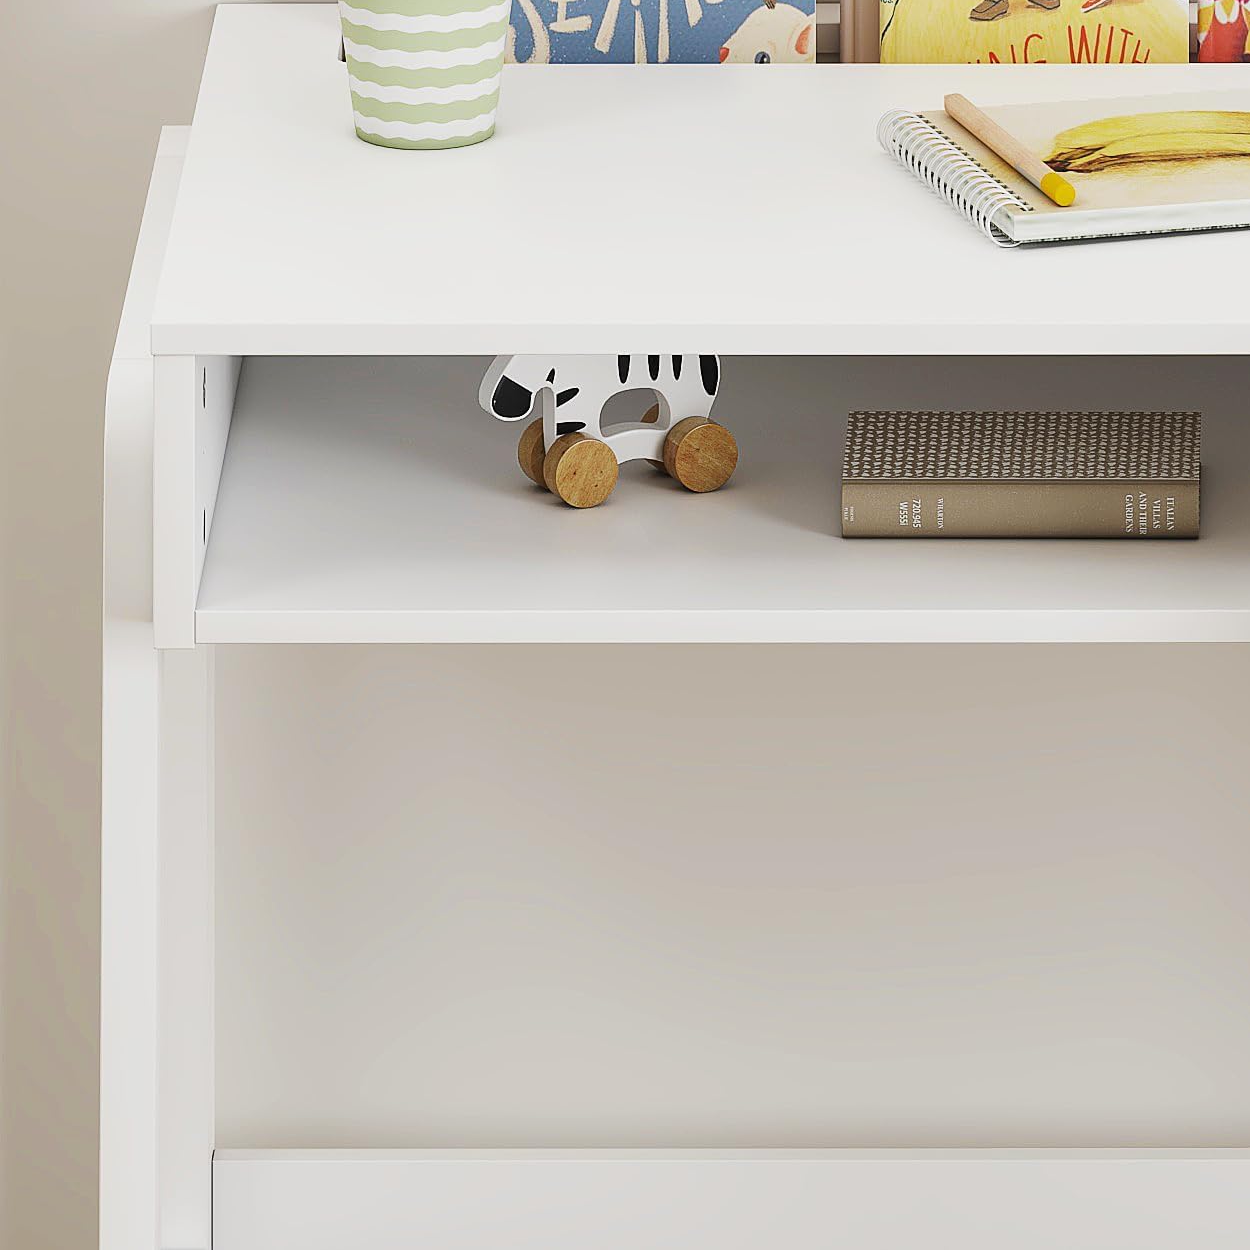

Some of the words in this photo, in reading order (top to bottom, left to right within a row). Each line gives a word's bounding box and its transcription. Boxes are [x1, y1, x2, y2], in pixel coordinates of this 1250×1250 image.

[912, 498, 922, 528] 720.945
[936, 498, 944, 529] WHARTON
[1125, 494, 1134, 533] GARDENS
[1139, 491, 1148, 510] AND
[1152, 499, 1161, 529] VILLAS
[1166, 497, 1175, 530] ITALIAN
[1139, 511, 1148, 534] THEIR
